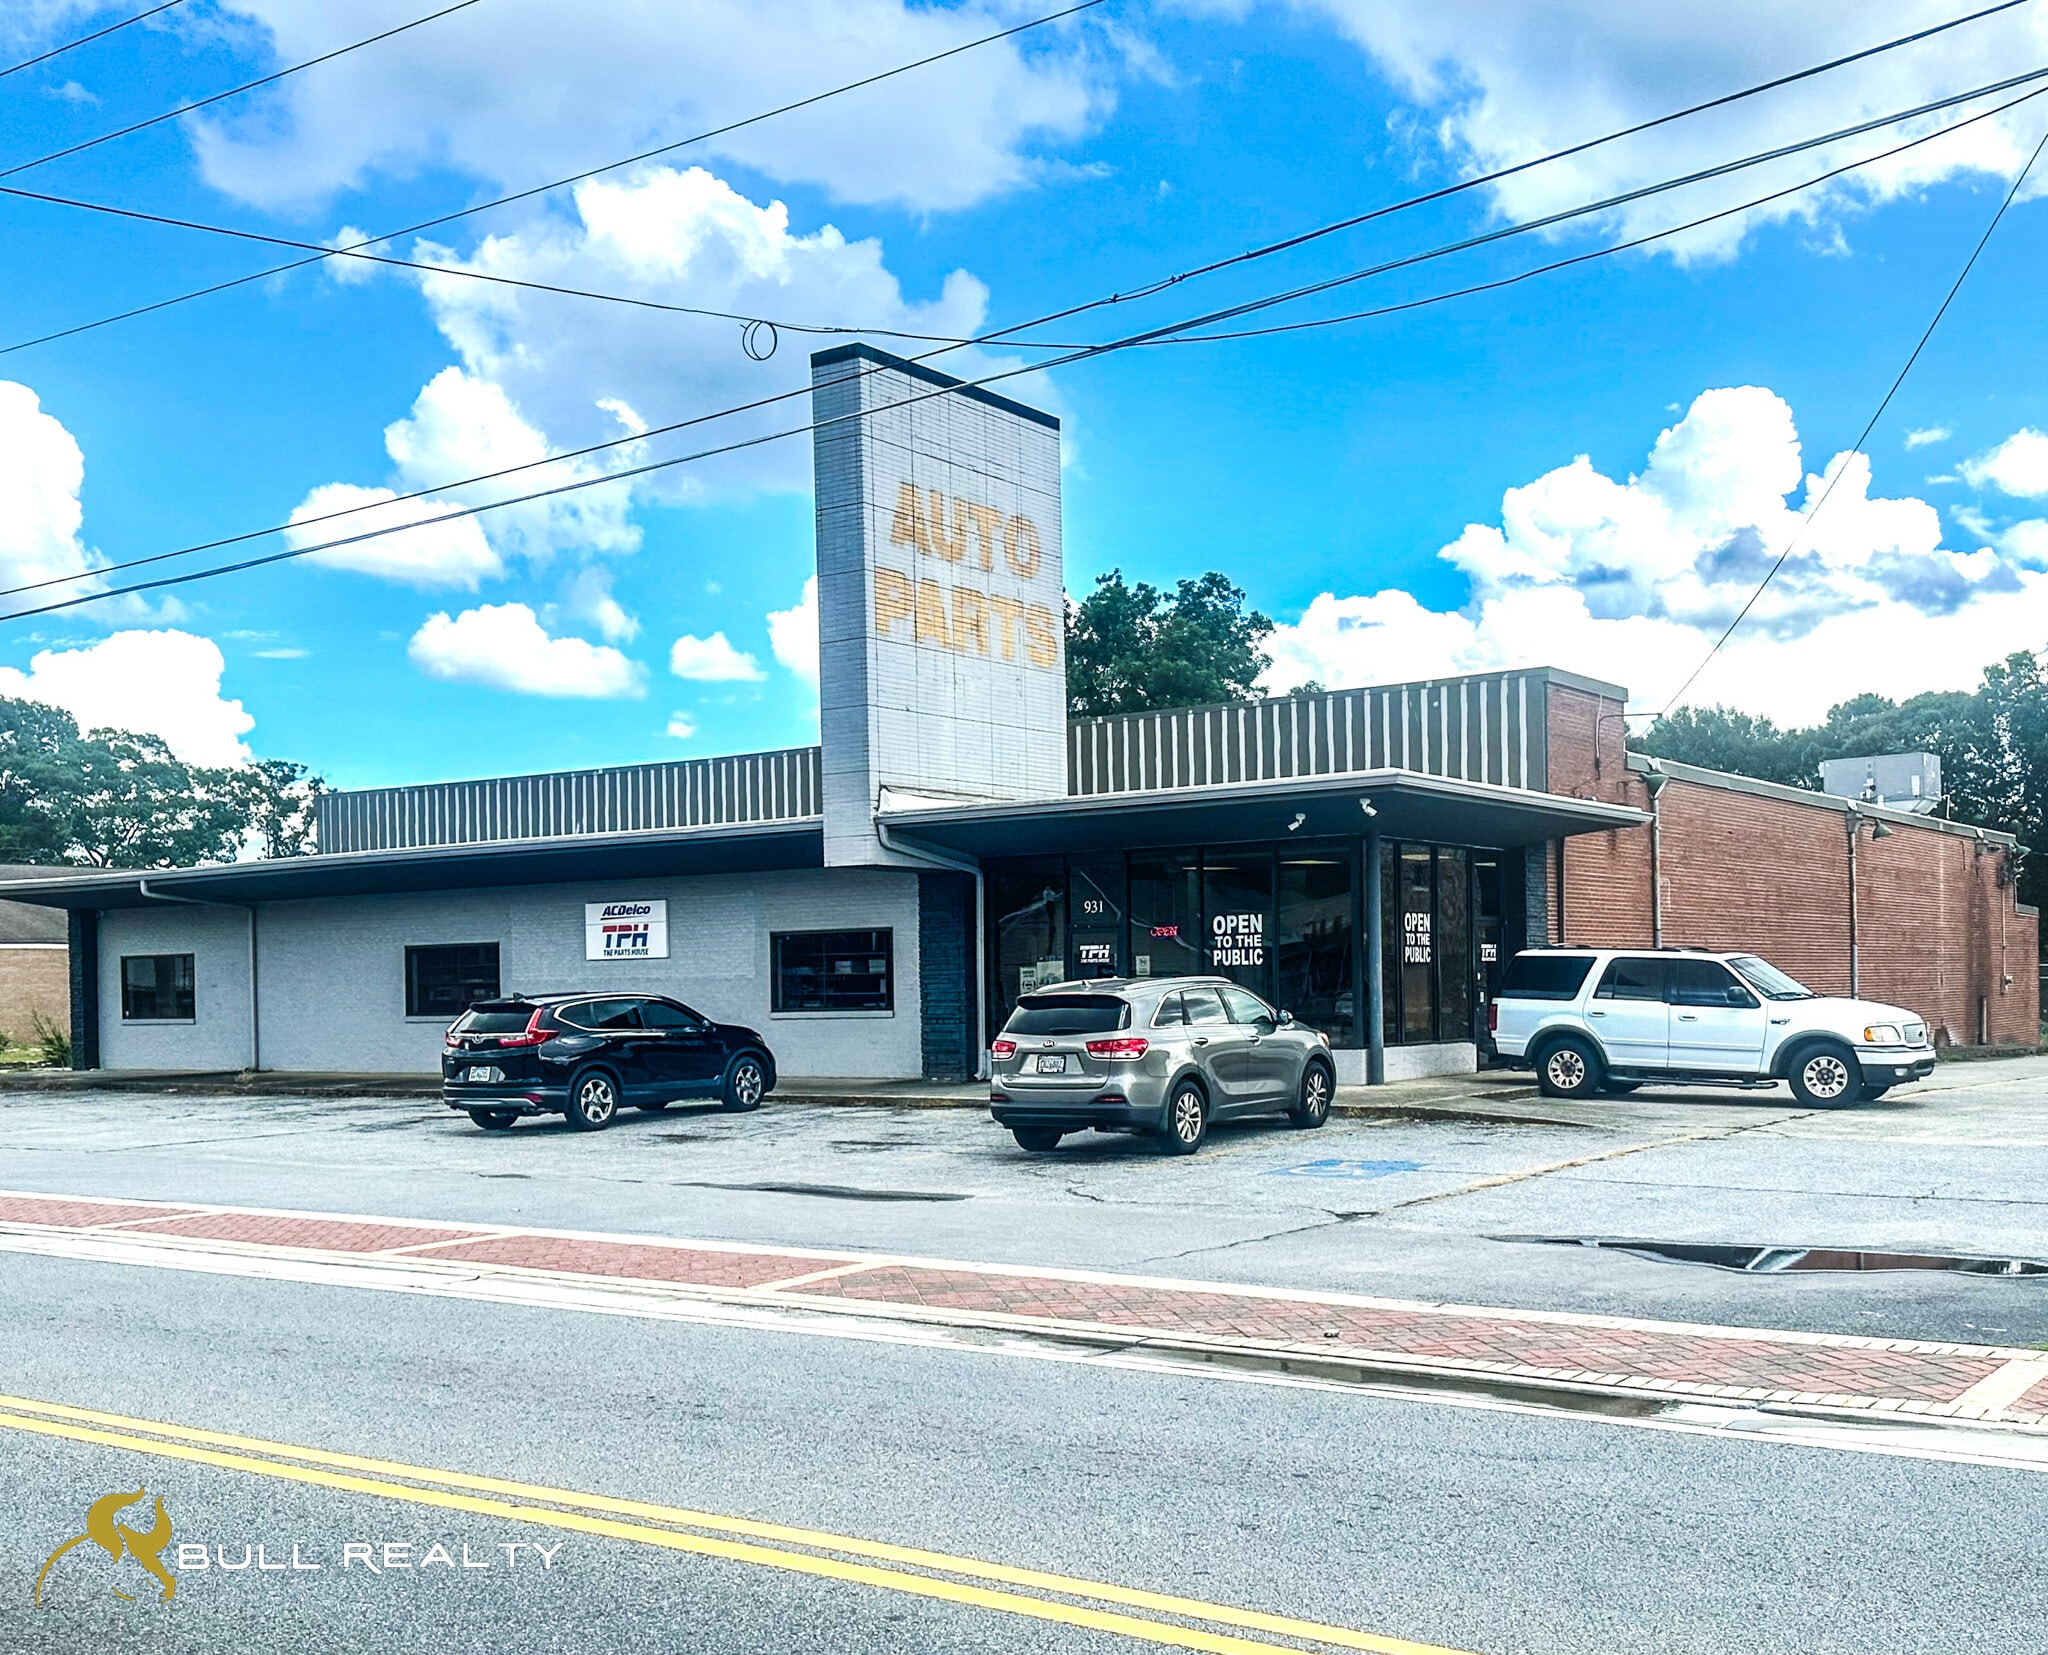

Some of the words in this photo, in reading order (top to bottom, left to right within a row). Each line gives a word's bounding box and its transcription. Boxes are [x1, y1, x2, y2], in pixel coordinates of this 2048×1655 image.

[890, 481, 1042, 579] AUTO
[873, 566, 1058, 669] PARTS
[602, 904, 651, 916] ACDelco
[1084, 900, 1104, 914] 931
[1213, 914, 1263, 935] OPEN
[1404, 912, 1431, 932] OPEN
[602, 924, 649, 948] TPH
[1150, 926, 1178, 937] OPEN
[1405, 933, 1415, 945] TO
[1416, 933, 1430, 945] THE
[1214, 935, 1232, 948] TO
[1235, 934, 1262, 947] THE
[631, 948, 649, 956] HOUSE
[1079, 944, 1110, 959] TPH
[1213, 948, 1264, 966] PUBLIC
[1404, 946, 1431, 963] PUBLIC
